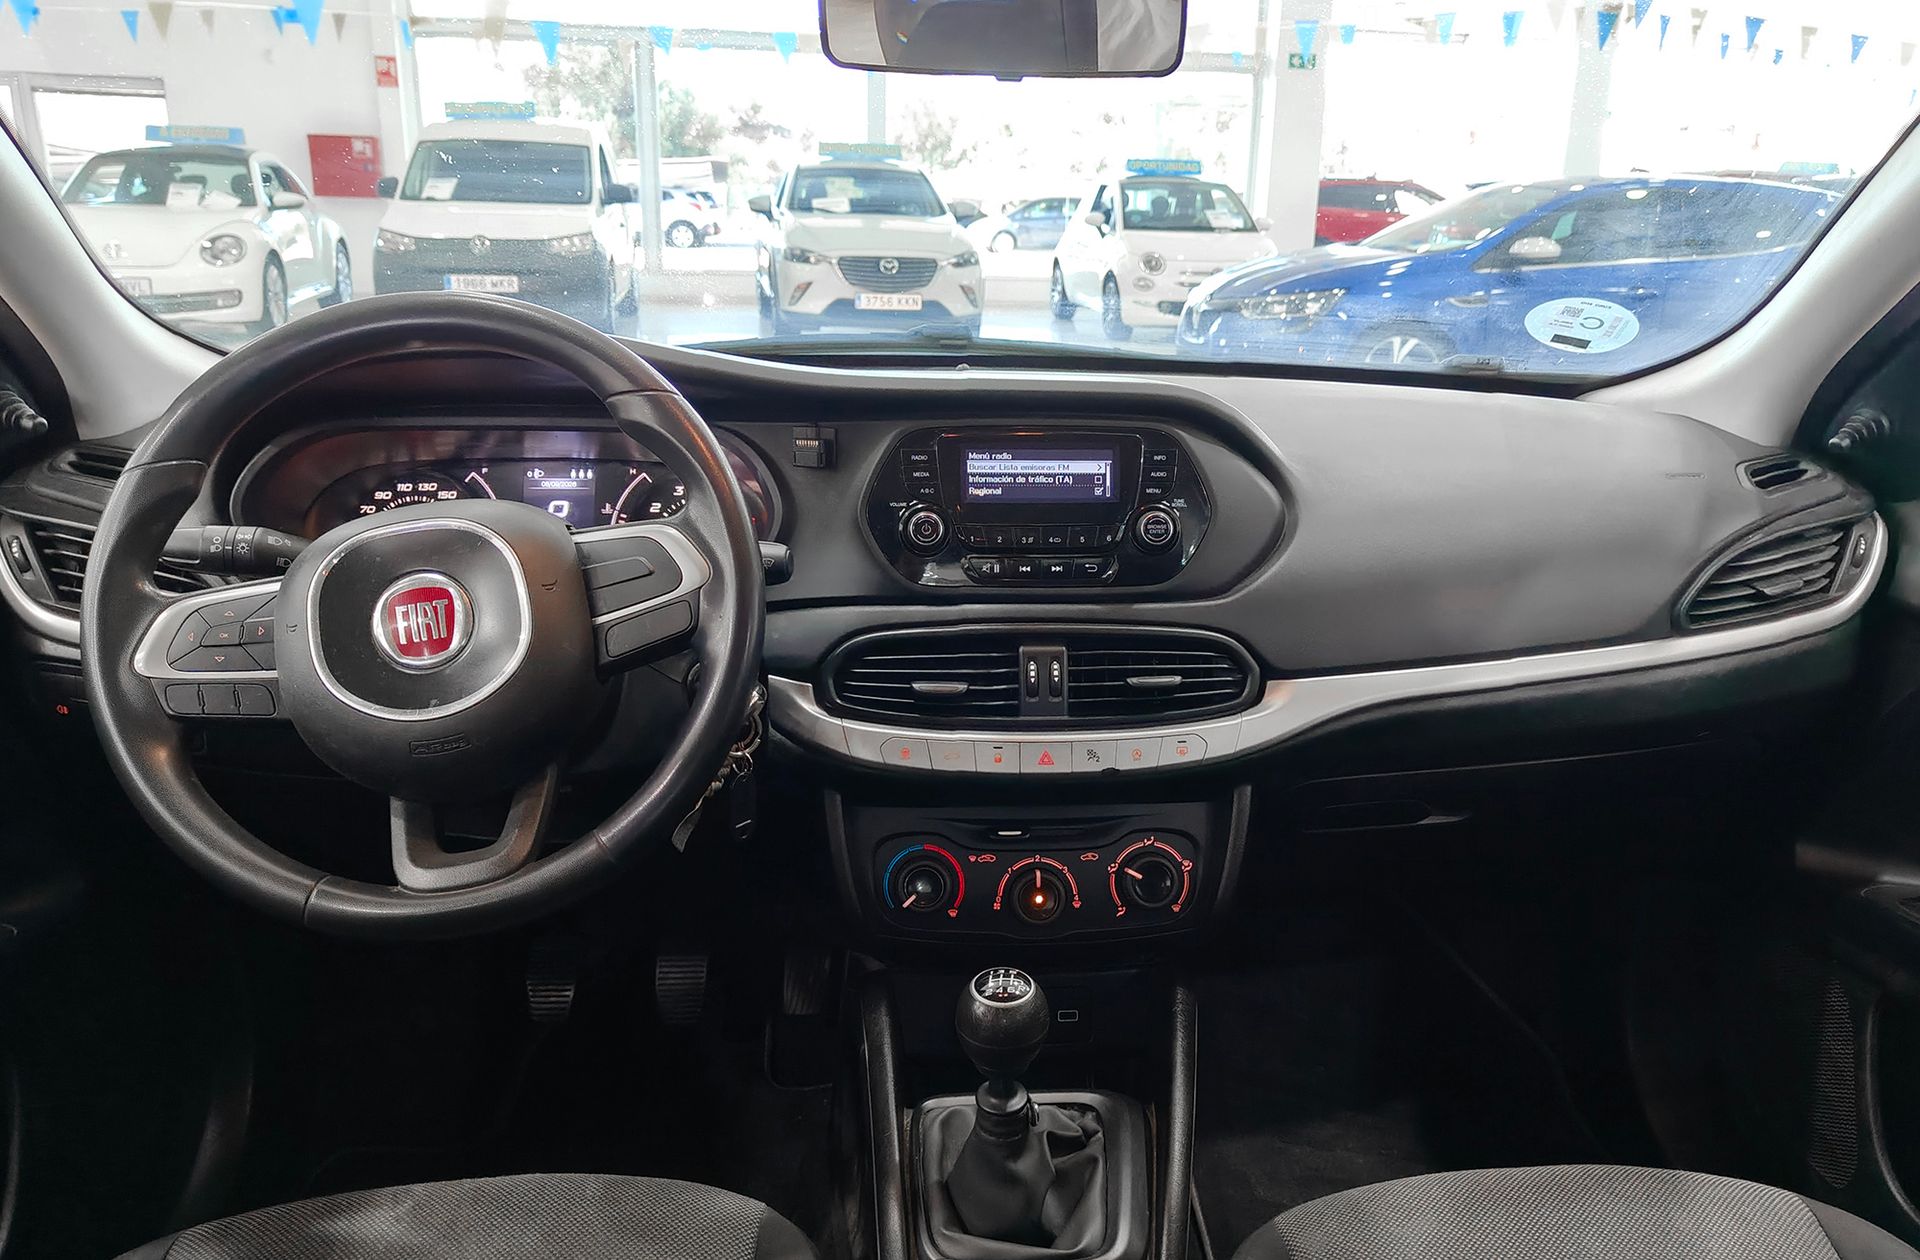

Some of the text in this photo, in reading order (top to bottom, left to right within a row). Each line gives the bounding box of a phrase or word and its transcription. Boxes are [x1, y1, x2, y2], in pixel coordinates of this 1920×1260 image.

[992, 452, 1012, 460] radio
[969, 463, 1070, 471] Buscar Lista emisoras FM
[968, 475, 1073, 485] Información de tráfico (TA)
[396, 483, 413, 492] 110
[418, 482, 438, 491] 130
[673, 485, 685, 496] 3
[968, 486, 1002, 496] Regional
[374, 491, 392, 500] 90
[437, 490, 457, 499] 150
[360, 505, 376, 514] 70
[649, 502, 662, 513] 2
[395, 599, 449, 645] FIAT
[1034, 854, 1041, 862] 2
[1062, 865, 1069, 874] 3
